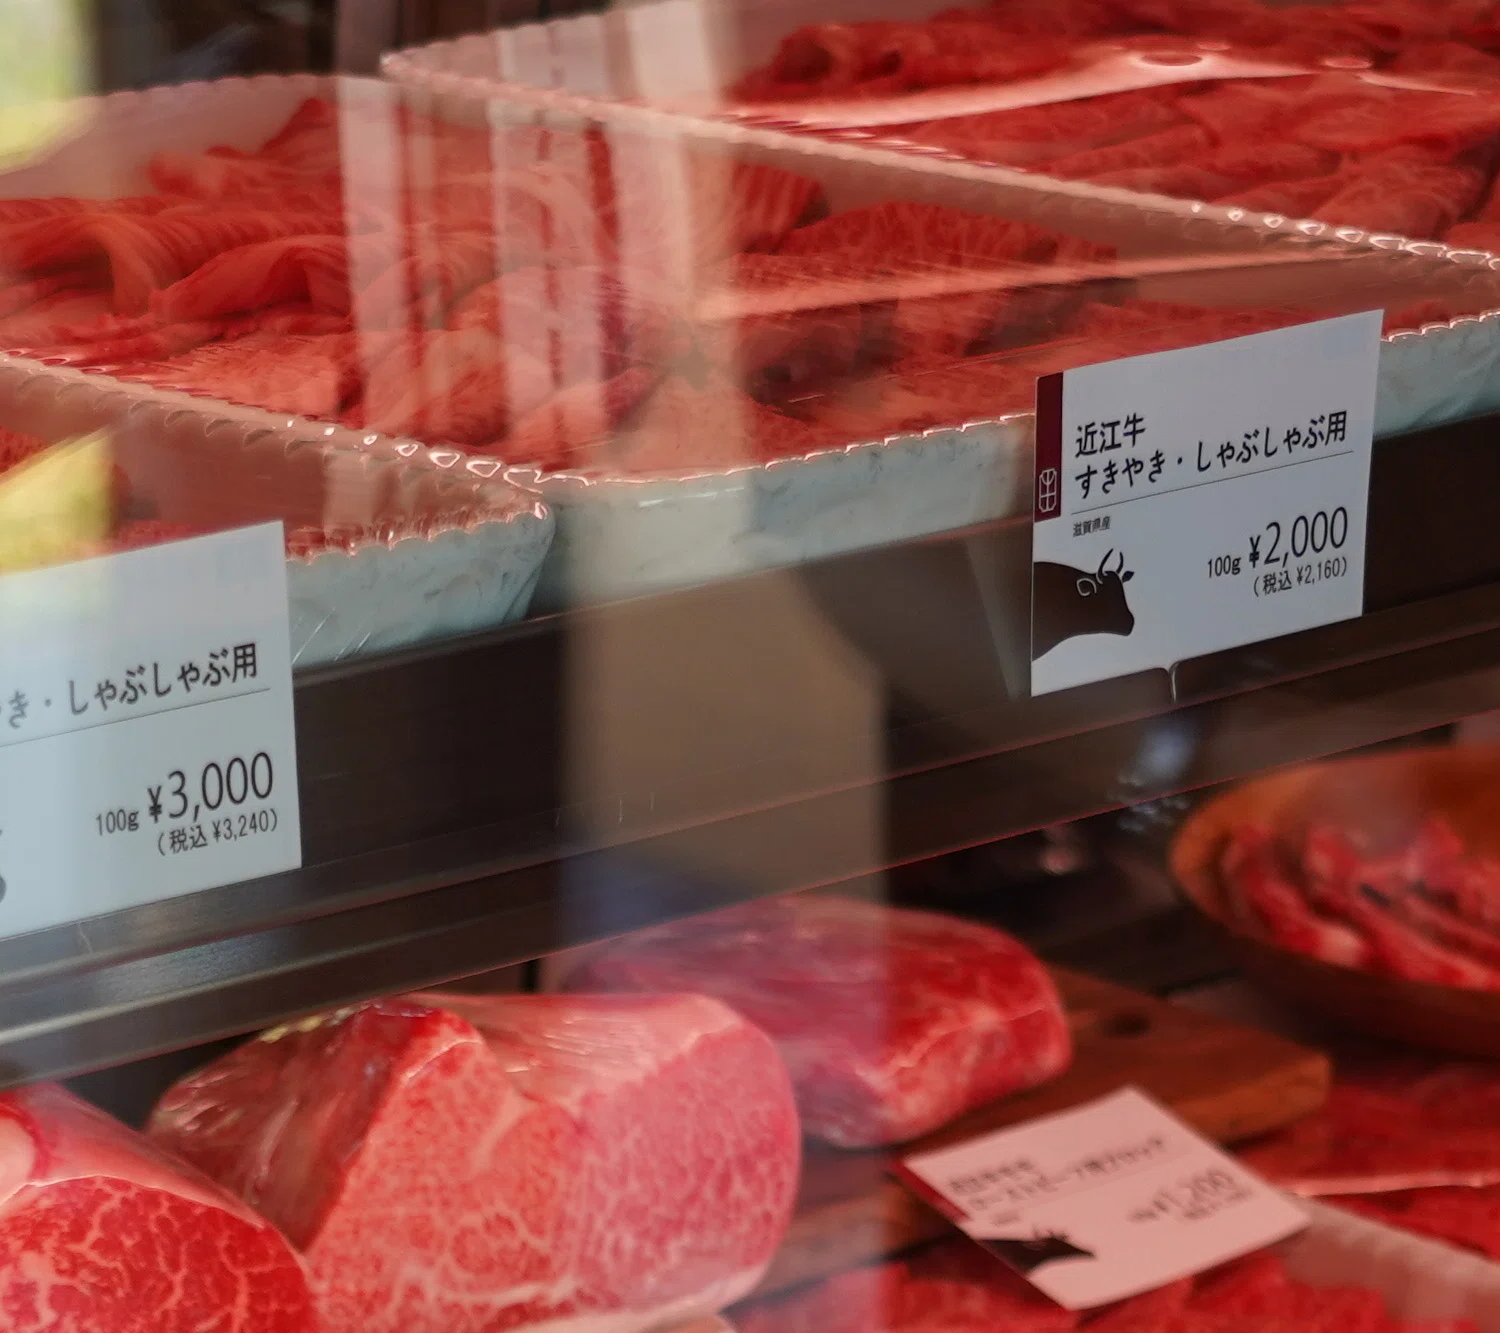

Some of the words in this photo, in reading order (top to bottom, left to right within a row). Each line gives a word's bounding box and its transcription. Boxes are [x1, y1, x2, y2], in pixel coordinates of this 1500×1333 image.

[1074, 410, 1347, 499] すきやき・しゃぶしゃぶ用
[1075, 412, 1146, 458] 近江牛
[1207, 555, 1241, 578] 100g
[1249, 507, 1348, 568] ¥2,000
[1253, 570, 1291, 596] (税込
[1296, 556, 1347, 584] ¥2,160)
[95, 811, 140, 836] 100g
[147, 752, 274, 824] ¥3,000
[157, 824, 207, 857] (税込
[211, 807, 278, 844] ¥3,240)
